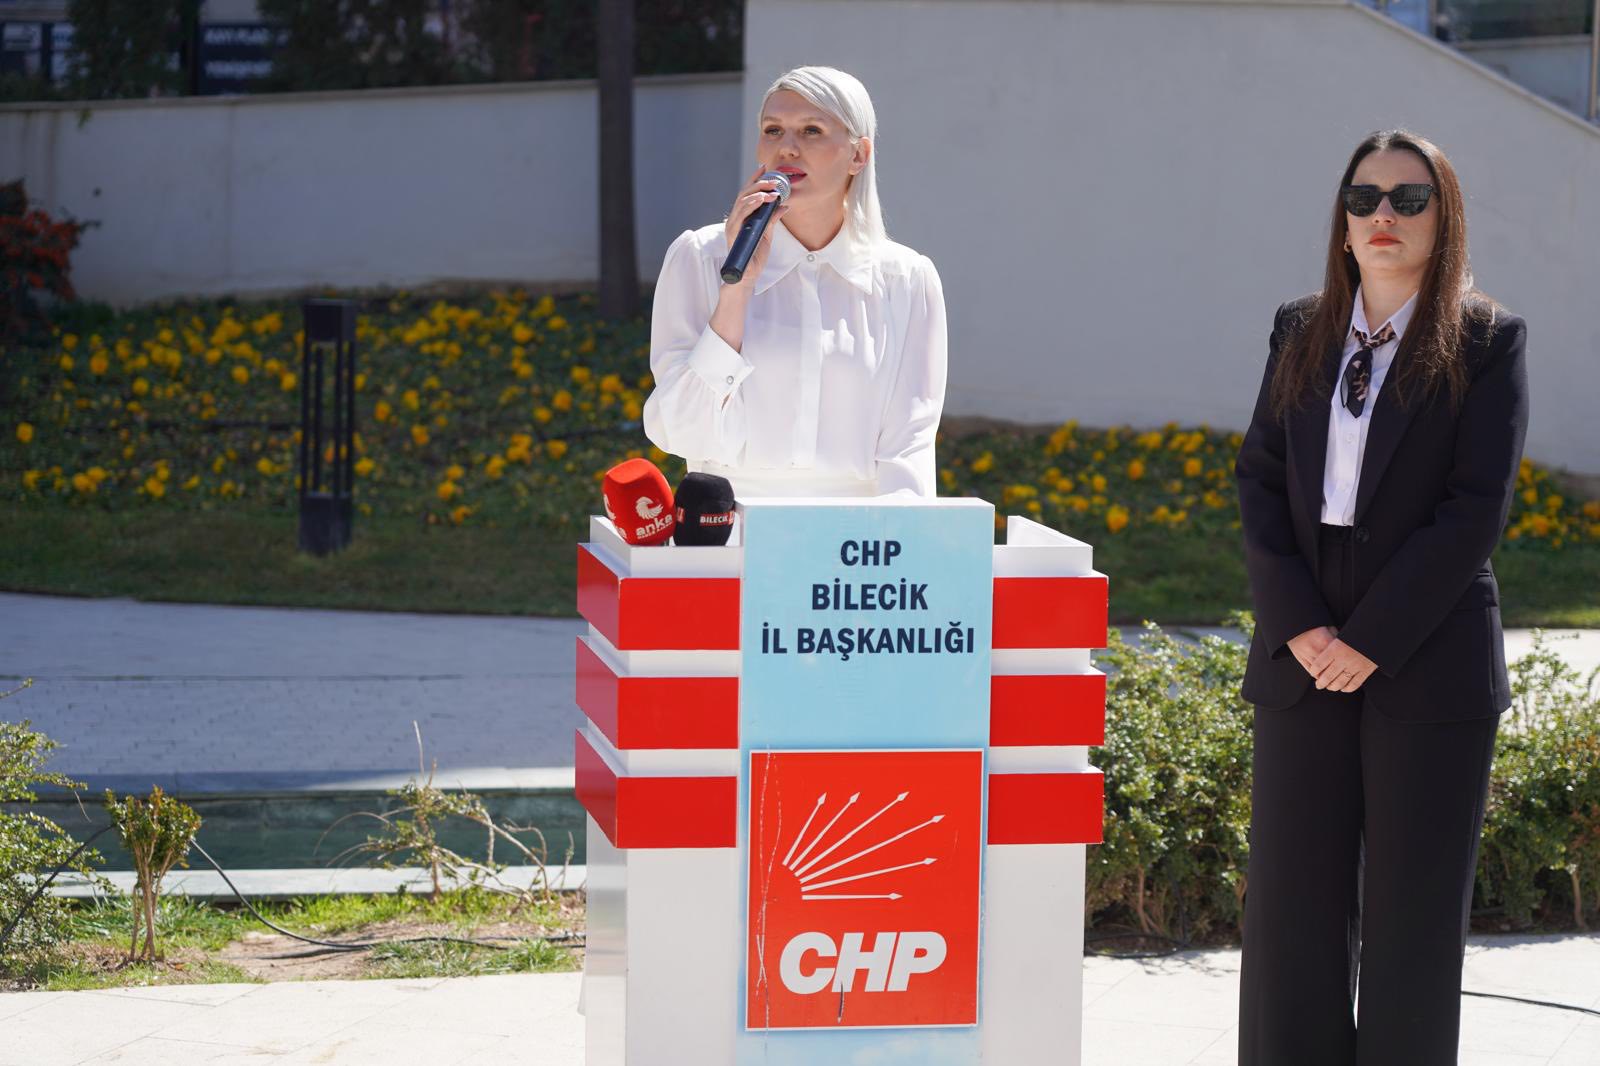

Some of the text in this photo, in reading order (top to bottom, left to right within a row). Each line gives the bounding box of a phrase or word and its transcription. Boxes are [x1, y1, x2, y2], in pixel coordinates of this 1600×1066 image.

[636, 514, 673, 536] anka
[840, 540, 902, 566] CHP
[812, 577, 928, 610] BİLECİK
[762, 621, 975, 661] İL BAŞKANLIĞI
[779, 931, 947, 994] CHP
